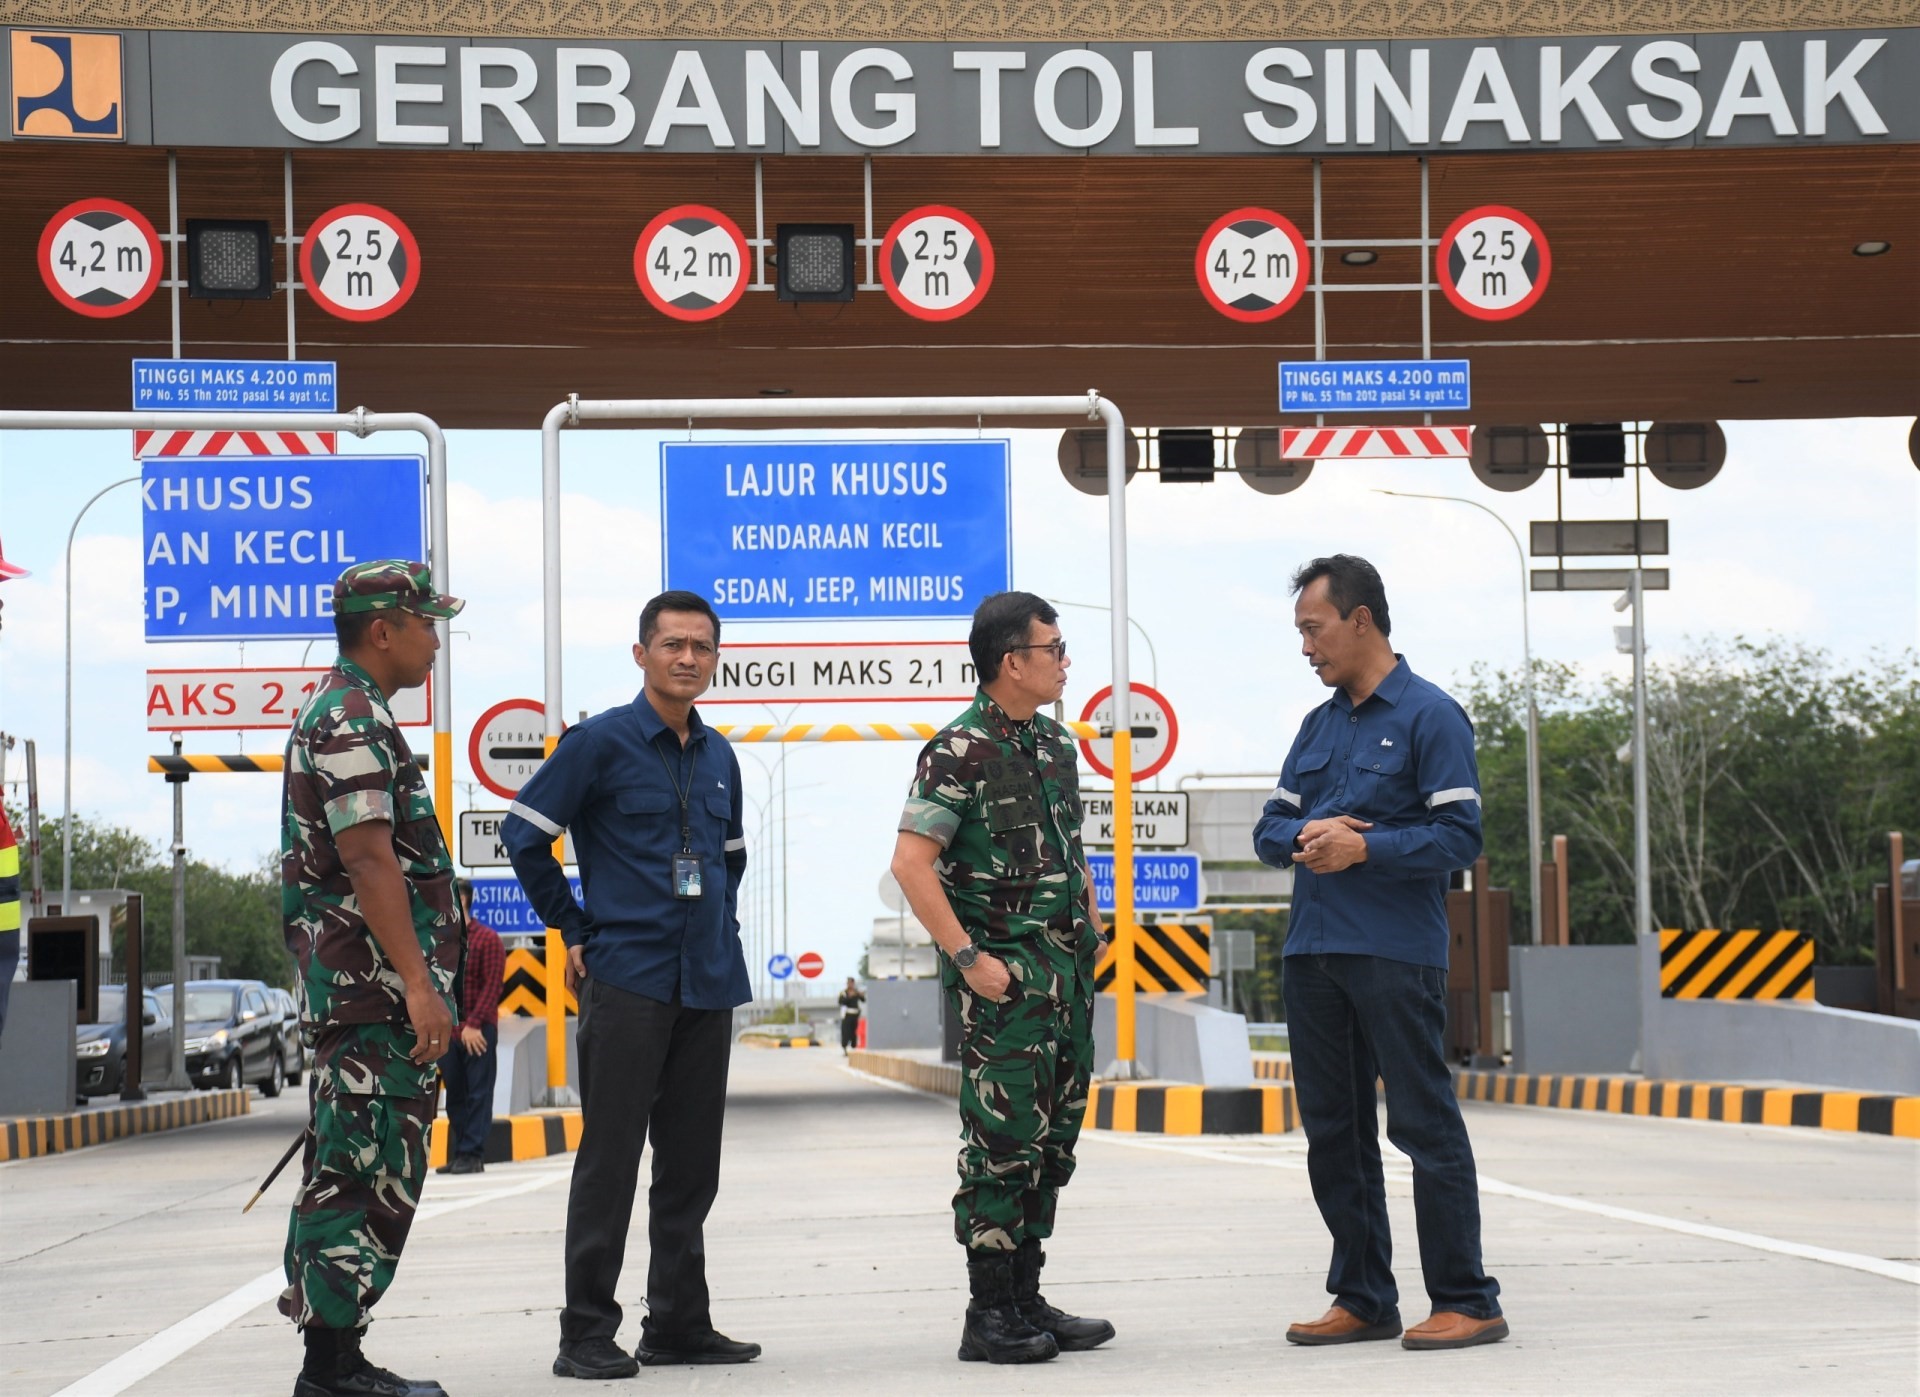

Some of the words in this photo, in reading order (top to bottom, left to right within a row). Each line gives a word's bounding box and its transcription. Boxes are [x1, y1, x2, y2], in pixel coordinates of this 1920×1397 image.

[270, 41, 917, 148] GERBANG
[953, 49, 1199, 148] TOL
[1243, 38, 1889, 146] SINAKSAK
[59, 241, 106, 278] 4,2
[117, 244, 144, 273] m
[335, 229, 382, 267] 2,5
[914, 229, 958, 266] 2,5
[1471, 229, 1516, 267] 2,5
[654, 245, 698, 283] 4,2
[707, 250, 732, 277] m
[1214, 249, 1256, 286] 4,2
[1266, 251, 1291, 278] m
[347, 268, 373, 297] m
[925, 268, 949, 296] m
[1482, 268, 1506, 296] m
[138, 368, 196, 384] TINGGI
[201, 369, 245, 384] MAKS
[251, 370, 298, 385] 4.200
[304, 372, 332, 385] mm
[1284, 371, 1337, 386] TINGGI
[1342, 370, 1384, 385] MAKS
[1388, 370, 1432, 385] 4.200
[1438, 371, 1465, 384] mm
[140, 388, 153, 400] PP
[157, 389, 173, 401] No.
[178, 389, 189, 401] 55
[194, 389, 211, 401] Thn
[216, 389, 238, 401] 2012
[243, 389, 269, 403] pasal
[273, 389, 285, 401] 54
[290, 390, 311, 404] ayat
[1286, 391, 1297, 402] PP
[1301, 391, 1316, 402] No.
[1336, 390, 1352, 401] Thn
[1356, 390, 1377, 401] 2012
[1381, 390, 1405, 403] pasal
[1409, 390, 1421, 401] 54
[1424, 390, 1444, 403] ayat
[142, 475, 313, 511] KHUSUS
[725, 463, 816, 497] LAJUR
[831, 461, 948, 496] KHUSUS
[235, 529, 356, 564] KECIL
[732, 523, 869, 550] KENDARAAN
[882, 522, 943, 548] KECIL
[713, 578, 794, 607] SEDAN,
[804, 577, 859, 606] JEEP,
[870, 575, 964, 602] MINIBUS
[814, 660, 893, 685] MAKS
[909, 659, 942, 688] 2,1
[147, 683, 237, 717] AKS
[1095, 711, 1161, 721] GEANG
[507, 765, 534, 775] TOL
[1144, 863, 1189, 880] SALDO
[472, 886, 525, 903] ASTIKA
[1135, 885, 1180, 902] CUKUP
